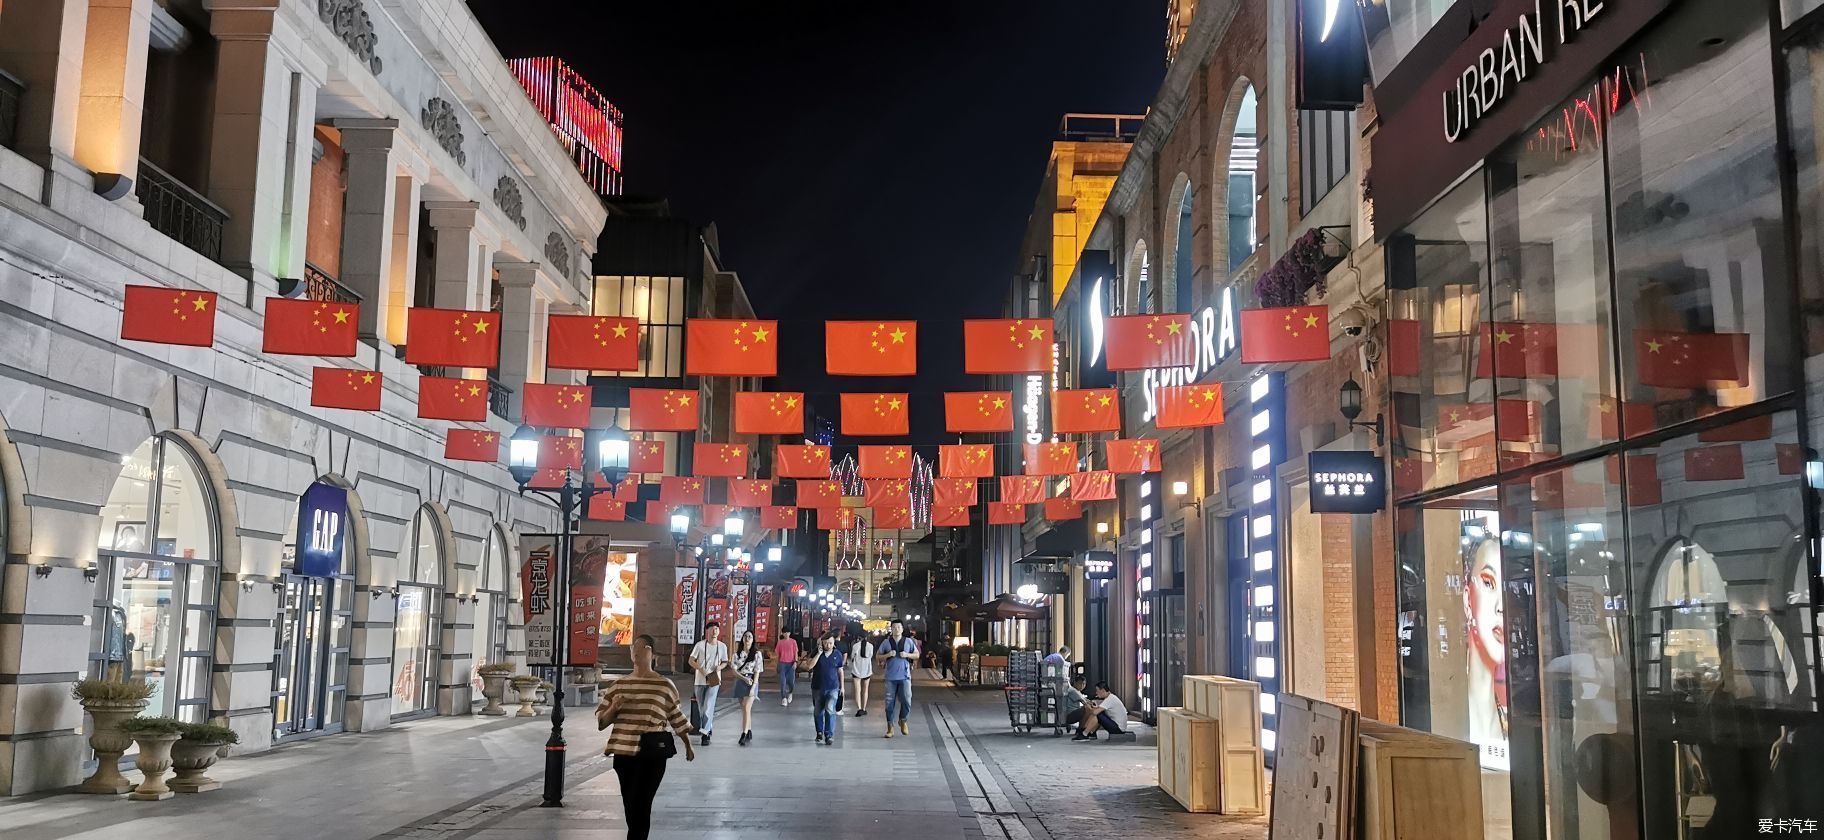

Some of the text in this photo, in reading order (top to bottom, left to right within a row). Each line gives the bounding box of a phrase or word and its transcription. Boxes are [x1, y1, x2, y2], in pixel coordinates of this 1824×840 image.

[1443, 0, 1543, 143] URBAN
[1314, 472, 1374, 483] SEPHORA
[312, 508, 339, 552] GAP
